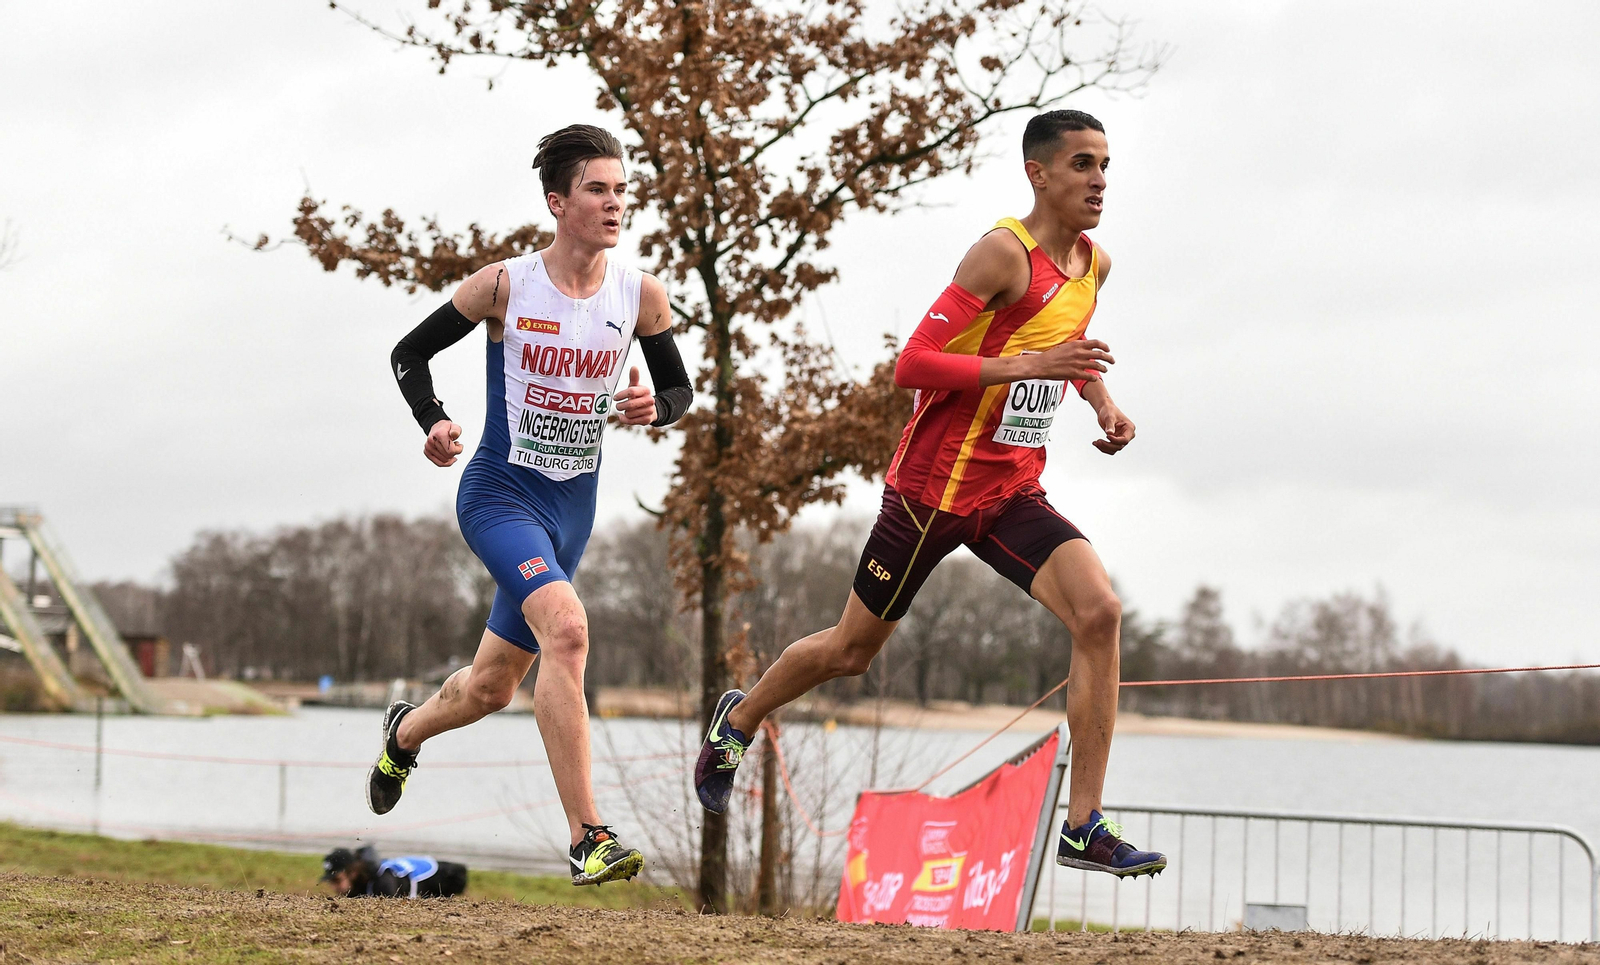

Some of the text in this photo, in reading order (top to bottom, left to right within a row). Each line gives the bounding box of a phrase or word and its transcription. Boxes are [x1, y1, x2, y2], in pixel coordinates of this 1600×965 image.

[532, 322, 559, 332] EXTRA
[521, 343, 623, 379] NORWAY
[528, 387, 594, 412] SPAR
[518, 409, 606, 445] INGEBRIGTSEN
[1019, 418, 1024, 427] I
[1024, 419, 1039, 428] RUN
[533, 442, 585, 456] I RUN CLEAN
[516, 450, 594, 471] TILBURG 2018
[867, 558, 892, 581] ESP
